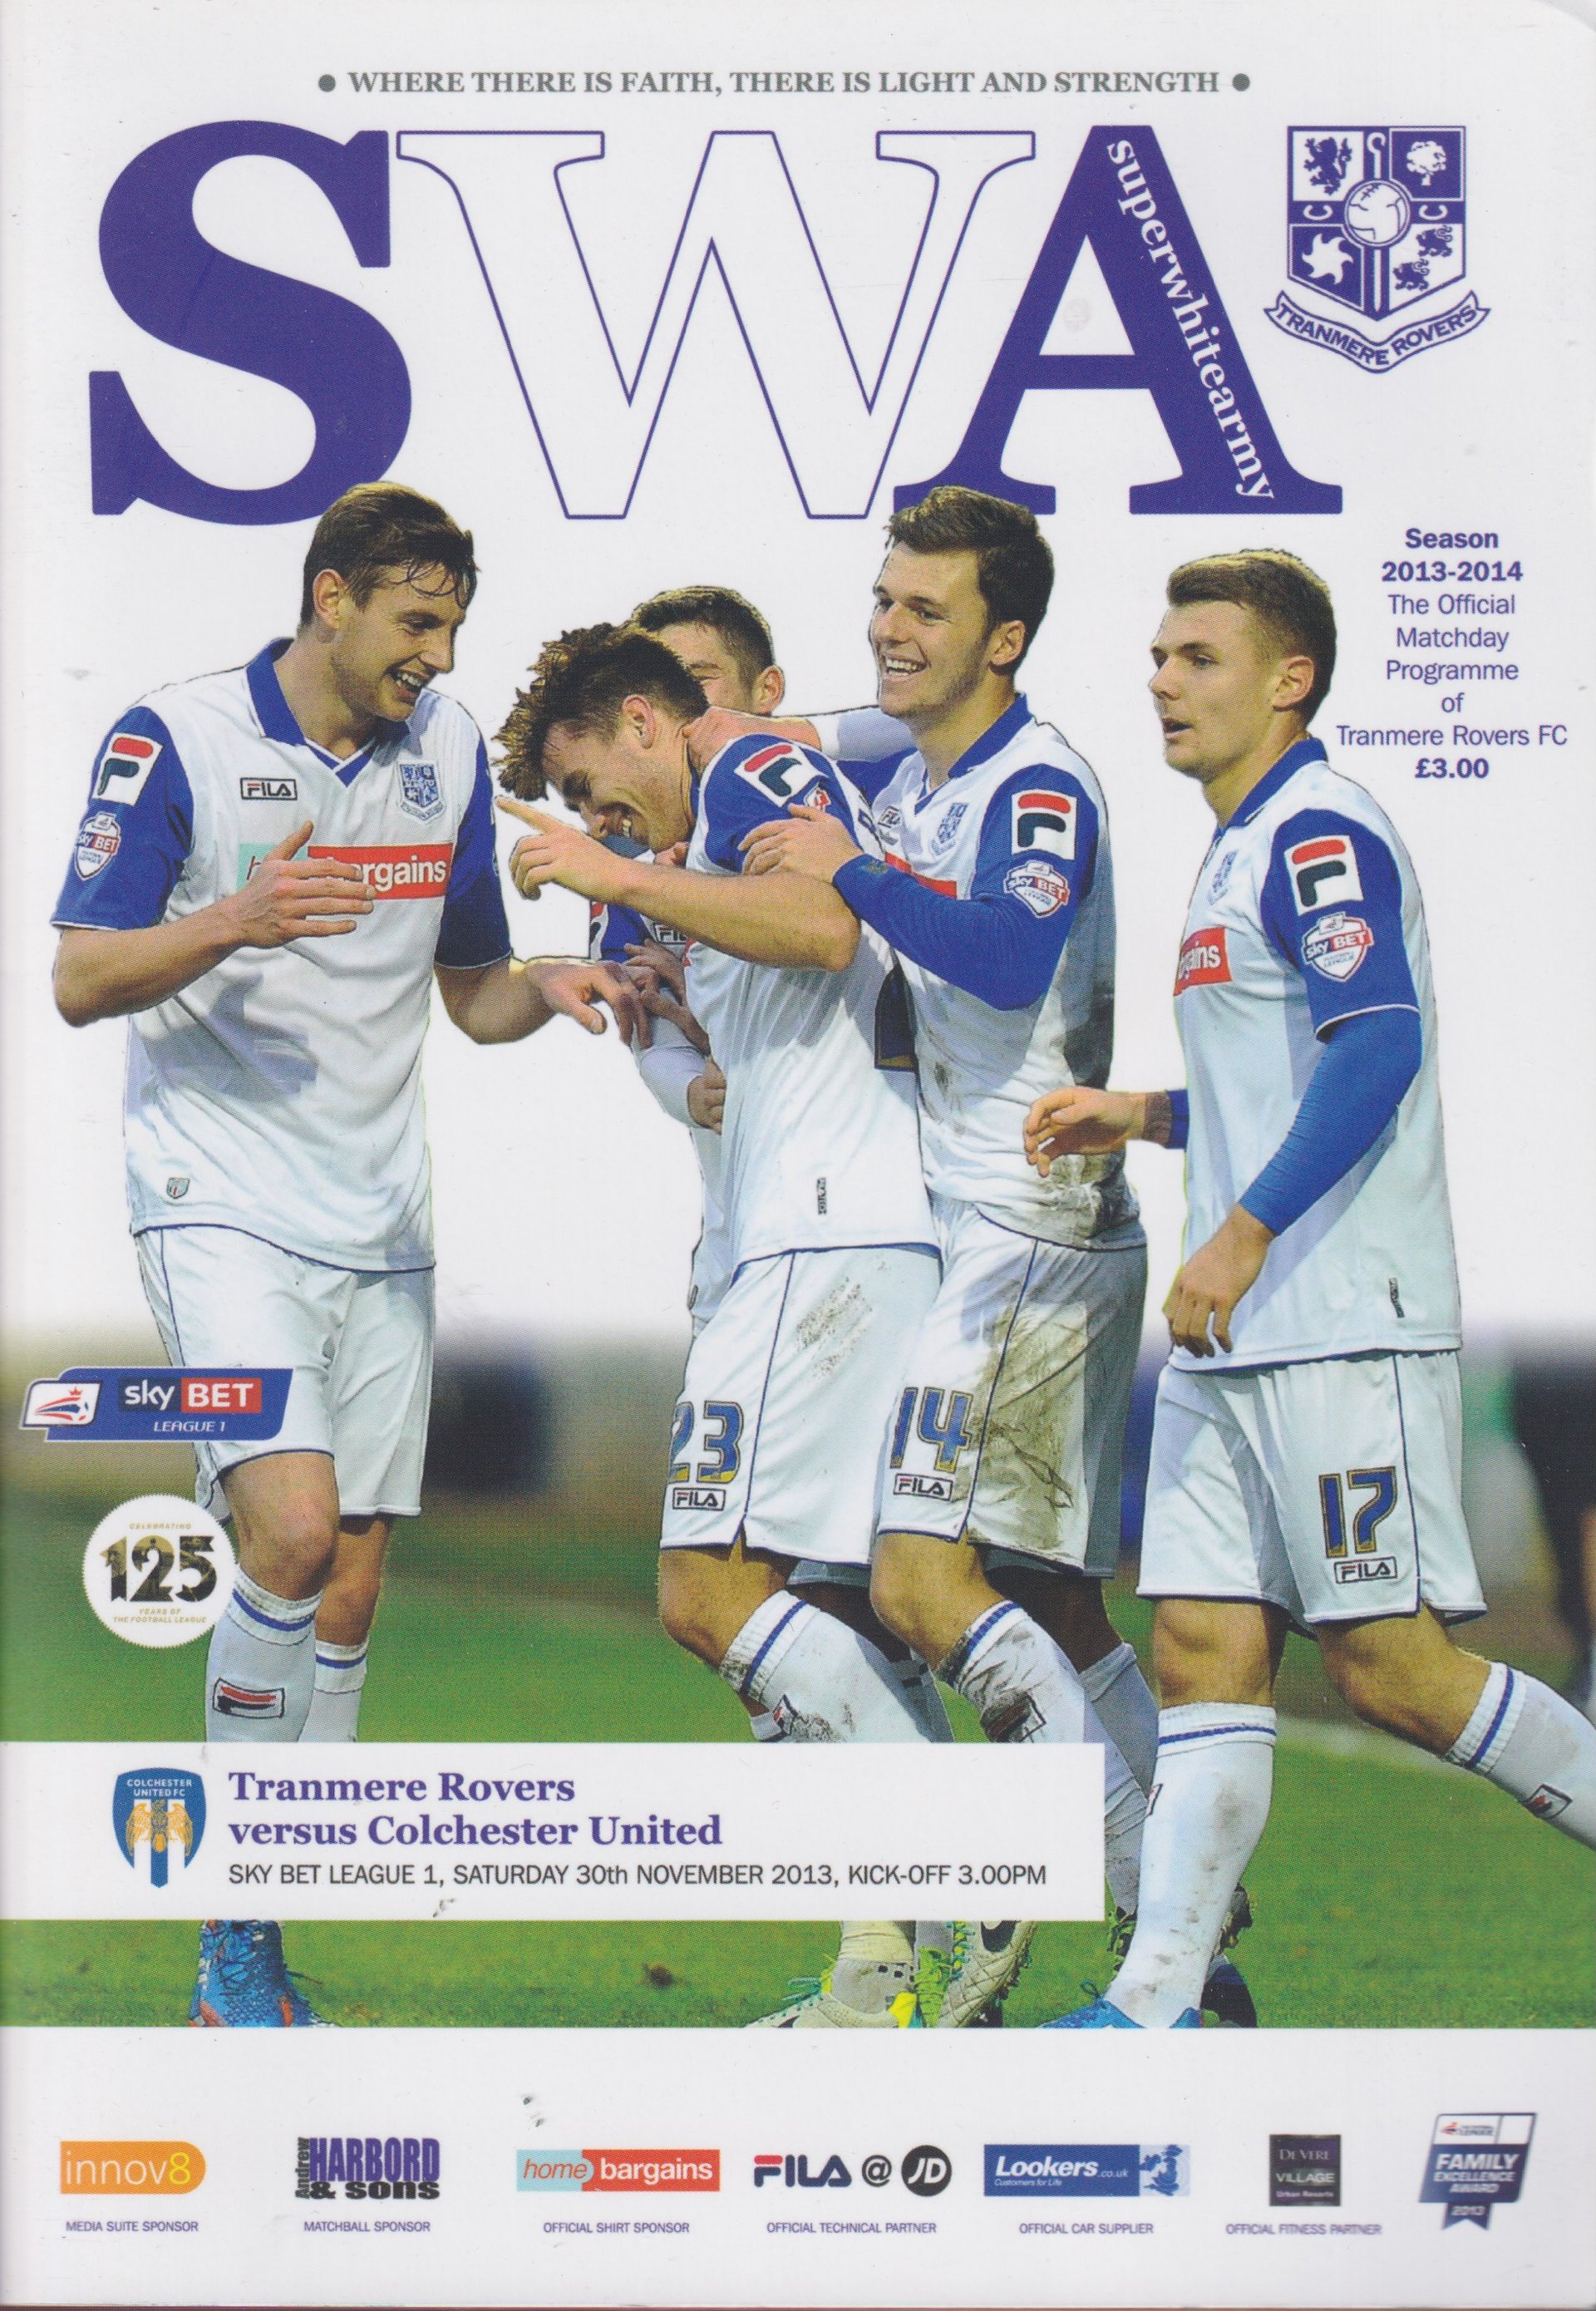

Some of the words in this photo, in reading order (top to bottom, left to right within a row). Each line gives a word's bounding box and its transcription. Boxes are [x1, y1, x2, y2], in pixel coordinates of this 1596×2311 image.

[346, 71, 466, 93] WHERE
[470, 71, 576, 93] THERE
[584, 71, 613, 94] IS
[620, 71, 722, 97] FAITH,
[729, 71, 835, 93] THERE
[842, 71, 871, 93] IS
[879, 71, 976, 93] LIGHT
[981, 71, 1047, 93] AND
[1054, 71, 1219, 93] STRENGTH
[89, 120, 1342, 526] SWA
[1108, 139, 1274, 500] superwhitearmy
[1276, 302, 1391, 366] TRANMERE
[1391, 303, 1478, 357] ROVERS
[1405, 527, 1500, 549] Season
[1382, 560, 1524, 583] 2013-2014
[1387, 594, 1430, 615] The
[1437, 593, 1515, 615] Official
[1396, 627, 1510, 653] Matchday
[1386, 659, 1520, 686] Programme
[1441, 692, 1465, 713] of
[1336, 724, 1445, 747] Tranmere
[1452, 724, 1530, 747] Rovers
[1538, 724, 1568, 747] FC
[1414, 757, 1490, 779] £3.00
[247, 782, 292, 796] FILA
[356, 855, 446, 893] rgains
[1332, 931, 1367, 950] BET
[124, 1377, 177, 1412] sky
[186, 1381, 255, 1408] BET
[153, 1422, 216, 1432] LEAGUE
[219, 1422, 226, 1431] 1
[889, 1387, 973, 1473] 14
[668, 1401, 744, 1484] 23
[900, 1477, 945, 1495] FILA
[677, 1491, 718, 1507] FILA
[1318, 1466, 1398, 1559] 17
[100, 1535, 217, 1603] 125
[1340, 1562, 1391, 1579] FILA
[126, 1778, 192, 1787] COLCHESTER
[228, 1771, 427, 1802] Tranmere
[437, 1771, 575, 1802] Rovers
[227, 1823, 357, 1845] versus
[367, 1813, 579, 1845] Colchester
[588, 1814, 723, 1845] United
[229, 1863, 273, 1885] SKY
[280, 1864, 322, 1885] BET
[329, 1864, 416, 1885] LEAGUE
[423, 1864, 445, 1888] 1,
[453, 1864, 569, 1885] SATURDAY
[576, 1864, 628, 1886] 30th
[637, 1864, 764, 1885] NOVEMBER
[771, 1864, 840, 1888] 2013,
[849, 1864, 952, 1885] KICK-OFF
[958, 1864, 1047, 1885] 3.00PM
[66, 2151, 191, 2185] innov8
[294, 2136, 310, 2199] Andrew
[310, 2136, 441, 2182] HARBORD
[1436, 2154, 1520, 2170] FAMILY
[523, 2160, 588, 2179] home
[600, 2158, 713, 2185] bargains
[753, 2154, 853, 2188] FILA
[861, 2154, 893, 2187] @
[907, 2158, 947, 2184] JD
[1037, 2178, 1047, 2186] for
[1275, 2173, 1335, 2183] VILLAGE
[1433, 2171, 1516, 2182] EXCELLENCE
[310, 2181, 337, 2200] &
[344, 2181, 441, 2200] sons
[66, 2220, 104, 2232] MEDIA
[106, 2220, 139, 2232] SUITE
[141, 2220, 199, 2232] SPONSOR
[303, 2220, 371, 2233] MATCHBALL
[373, 2220, 431, 2233] SPONSOR
[543, 2221, 594, 2234] OFFICIAL
[596, 2222, 631, 2234] SHIRT
[633, 2221, 690, 2234] SPONSOR
[766, 2221, 817, 2234] OFFICIAL
[819, 2222, 882, 2234] TECHNICAL
[884, 2222, 937, 2234] PARTNER
[1018, 2222, 1069, 2235] OFFICIAL
[1071, 2222, 1096, 2235] CAR
[1098, 2222, 1154, 2235] SUPPLIER
[1225, 2223, 1276, 2235] OFFICIAL
[1278, 2223, 1327, 2235] FITNESS
[1329, 2224, 1382, 2235] PARTNER
